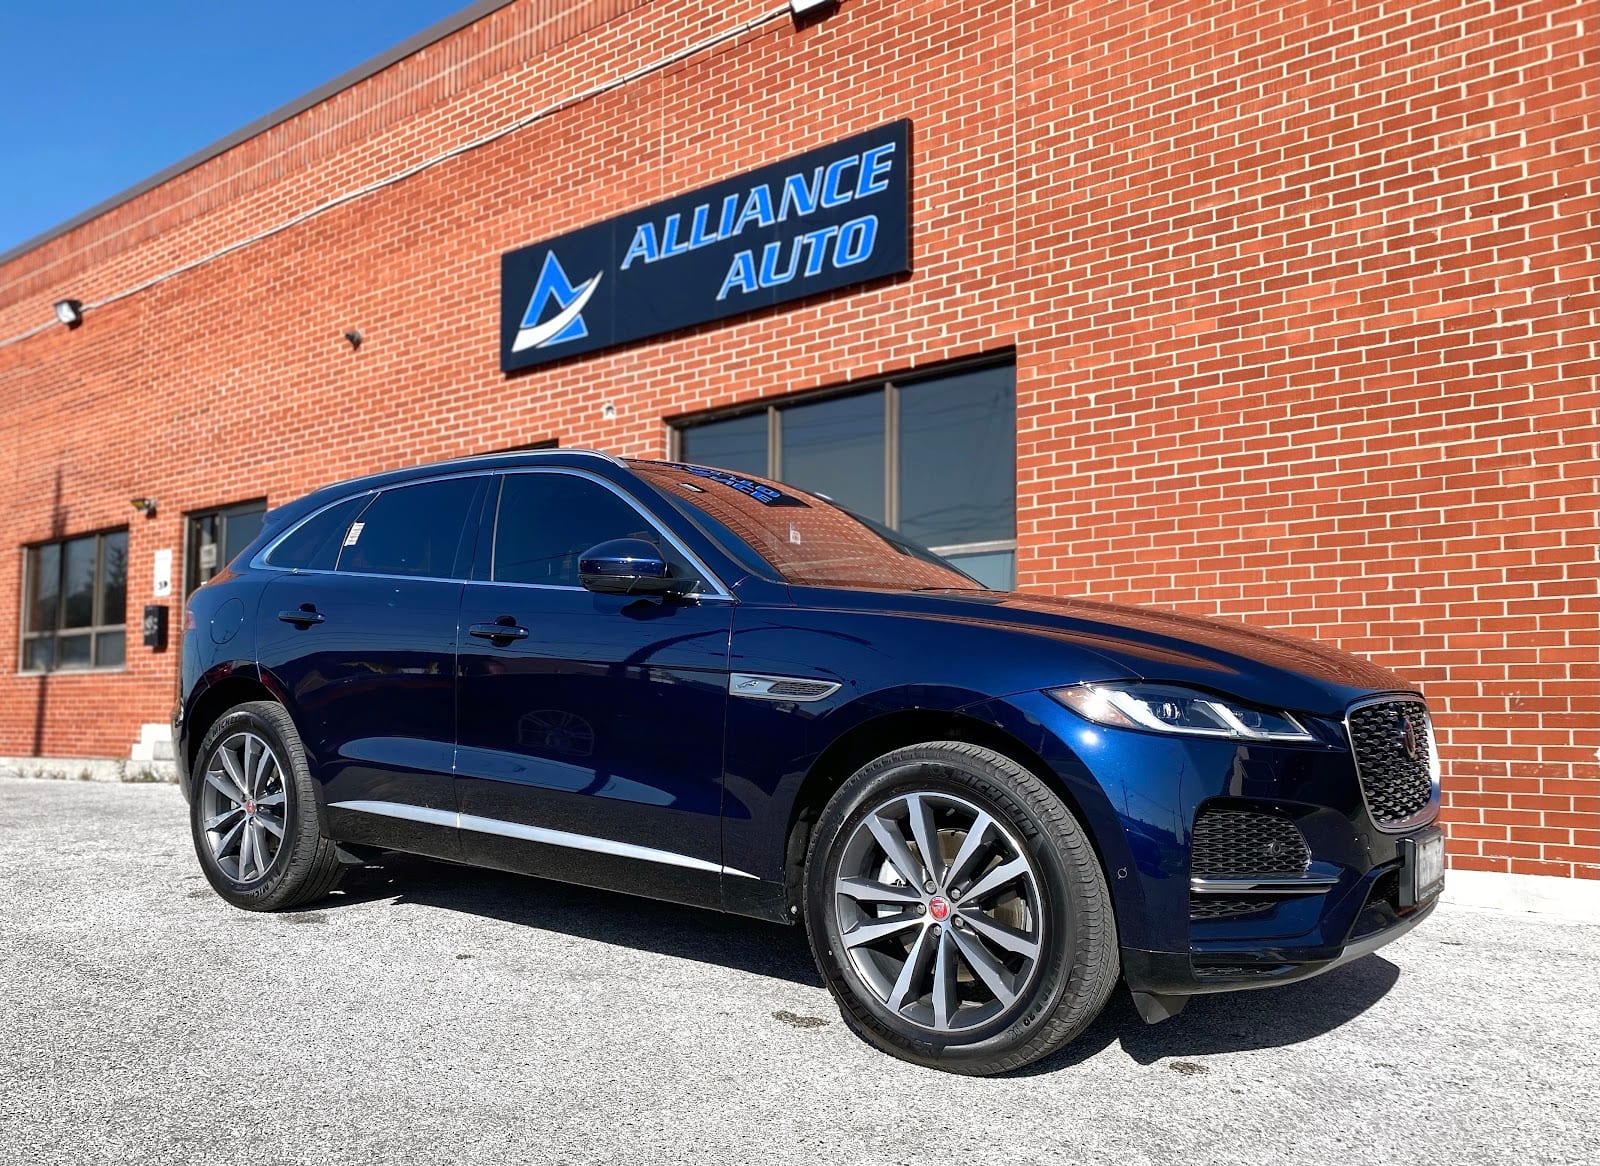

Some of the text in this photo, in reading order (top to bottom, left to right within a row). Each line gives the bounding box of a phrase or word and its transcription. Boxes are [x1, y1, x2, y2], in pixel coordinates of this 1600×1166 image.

[620, 142, 896, 270] ALLIANCE
[716, 214, 879, 301] AUTO
[952, 771, 1038, 838] MICHELIN
